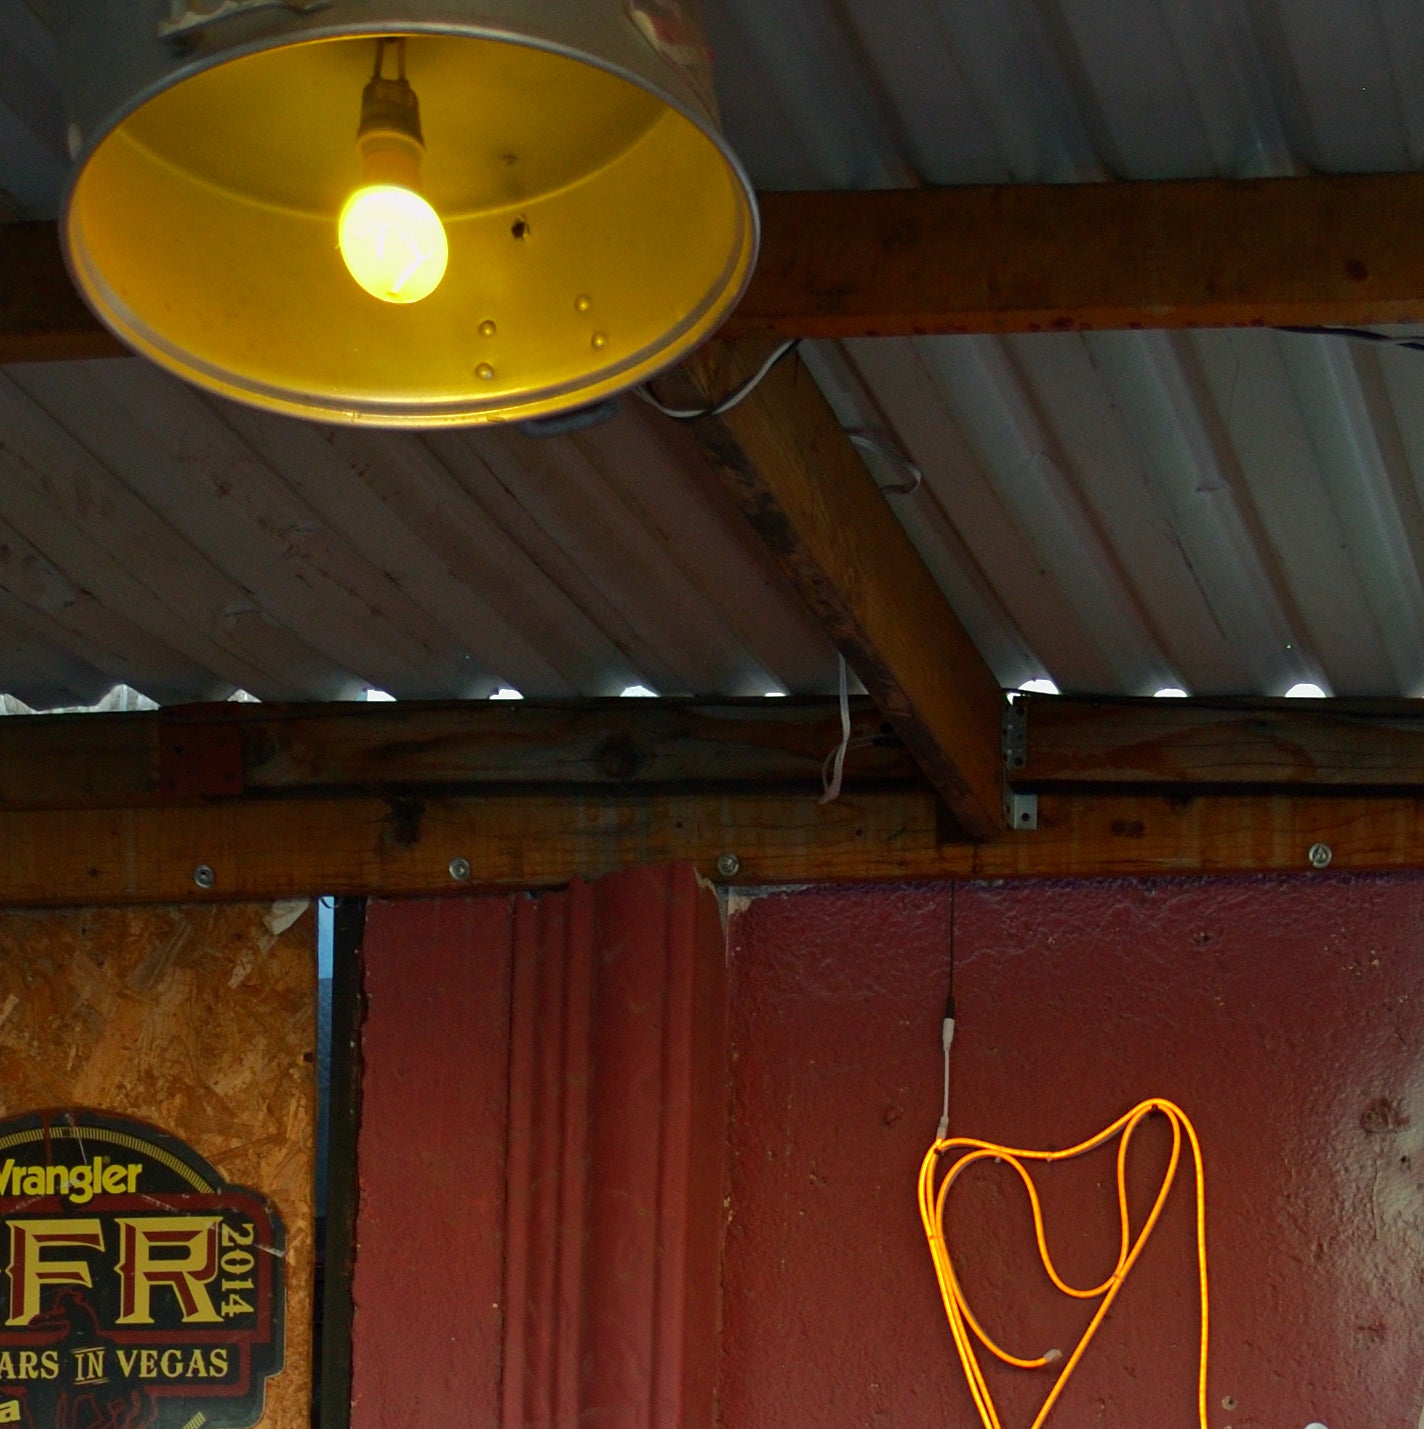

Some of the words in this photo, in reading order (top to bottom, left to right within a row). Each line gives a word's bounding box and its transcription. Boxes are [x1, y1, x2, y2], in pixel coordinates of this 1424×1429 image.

[220, 1223, 255, 1318] 2014
[73, 1349, 105, 1382] IN
[115, 1348, 229, 1379] VEGAS
